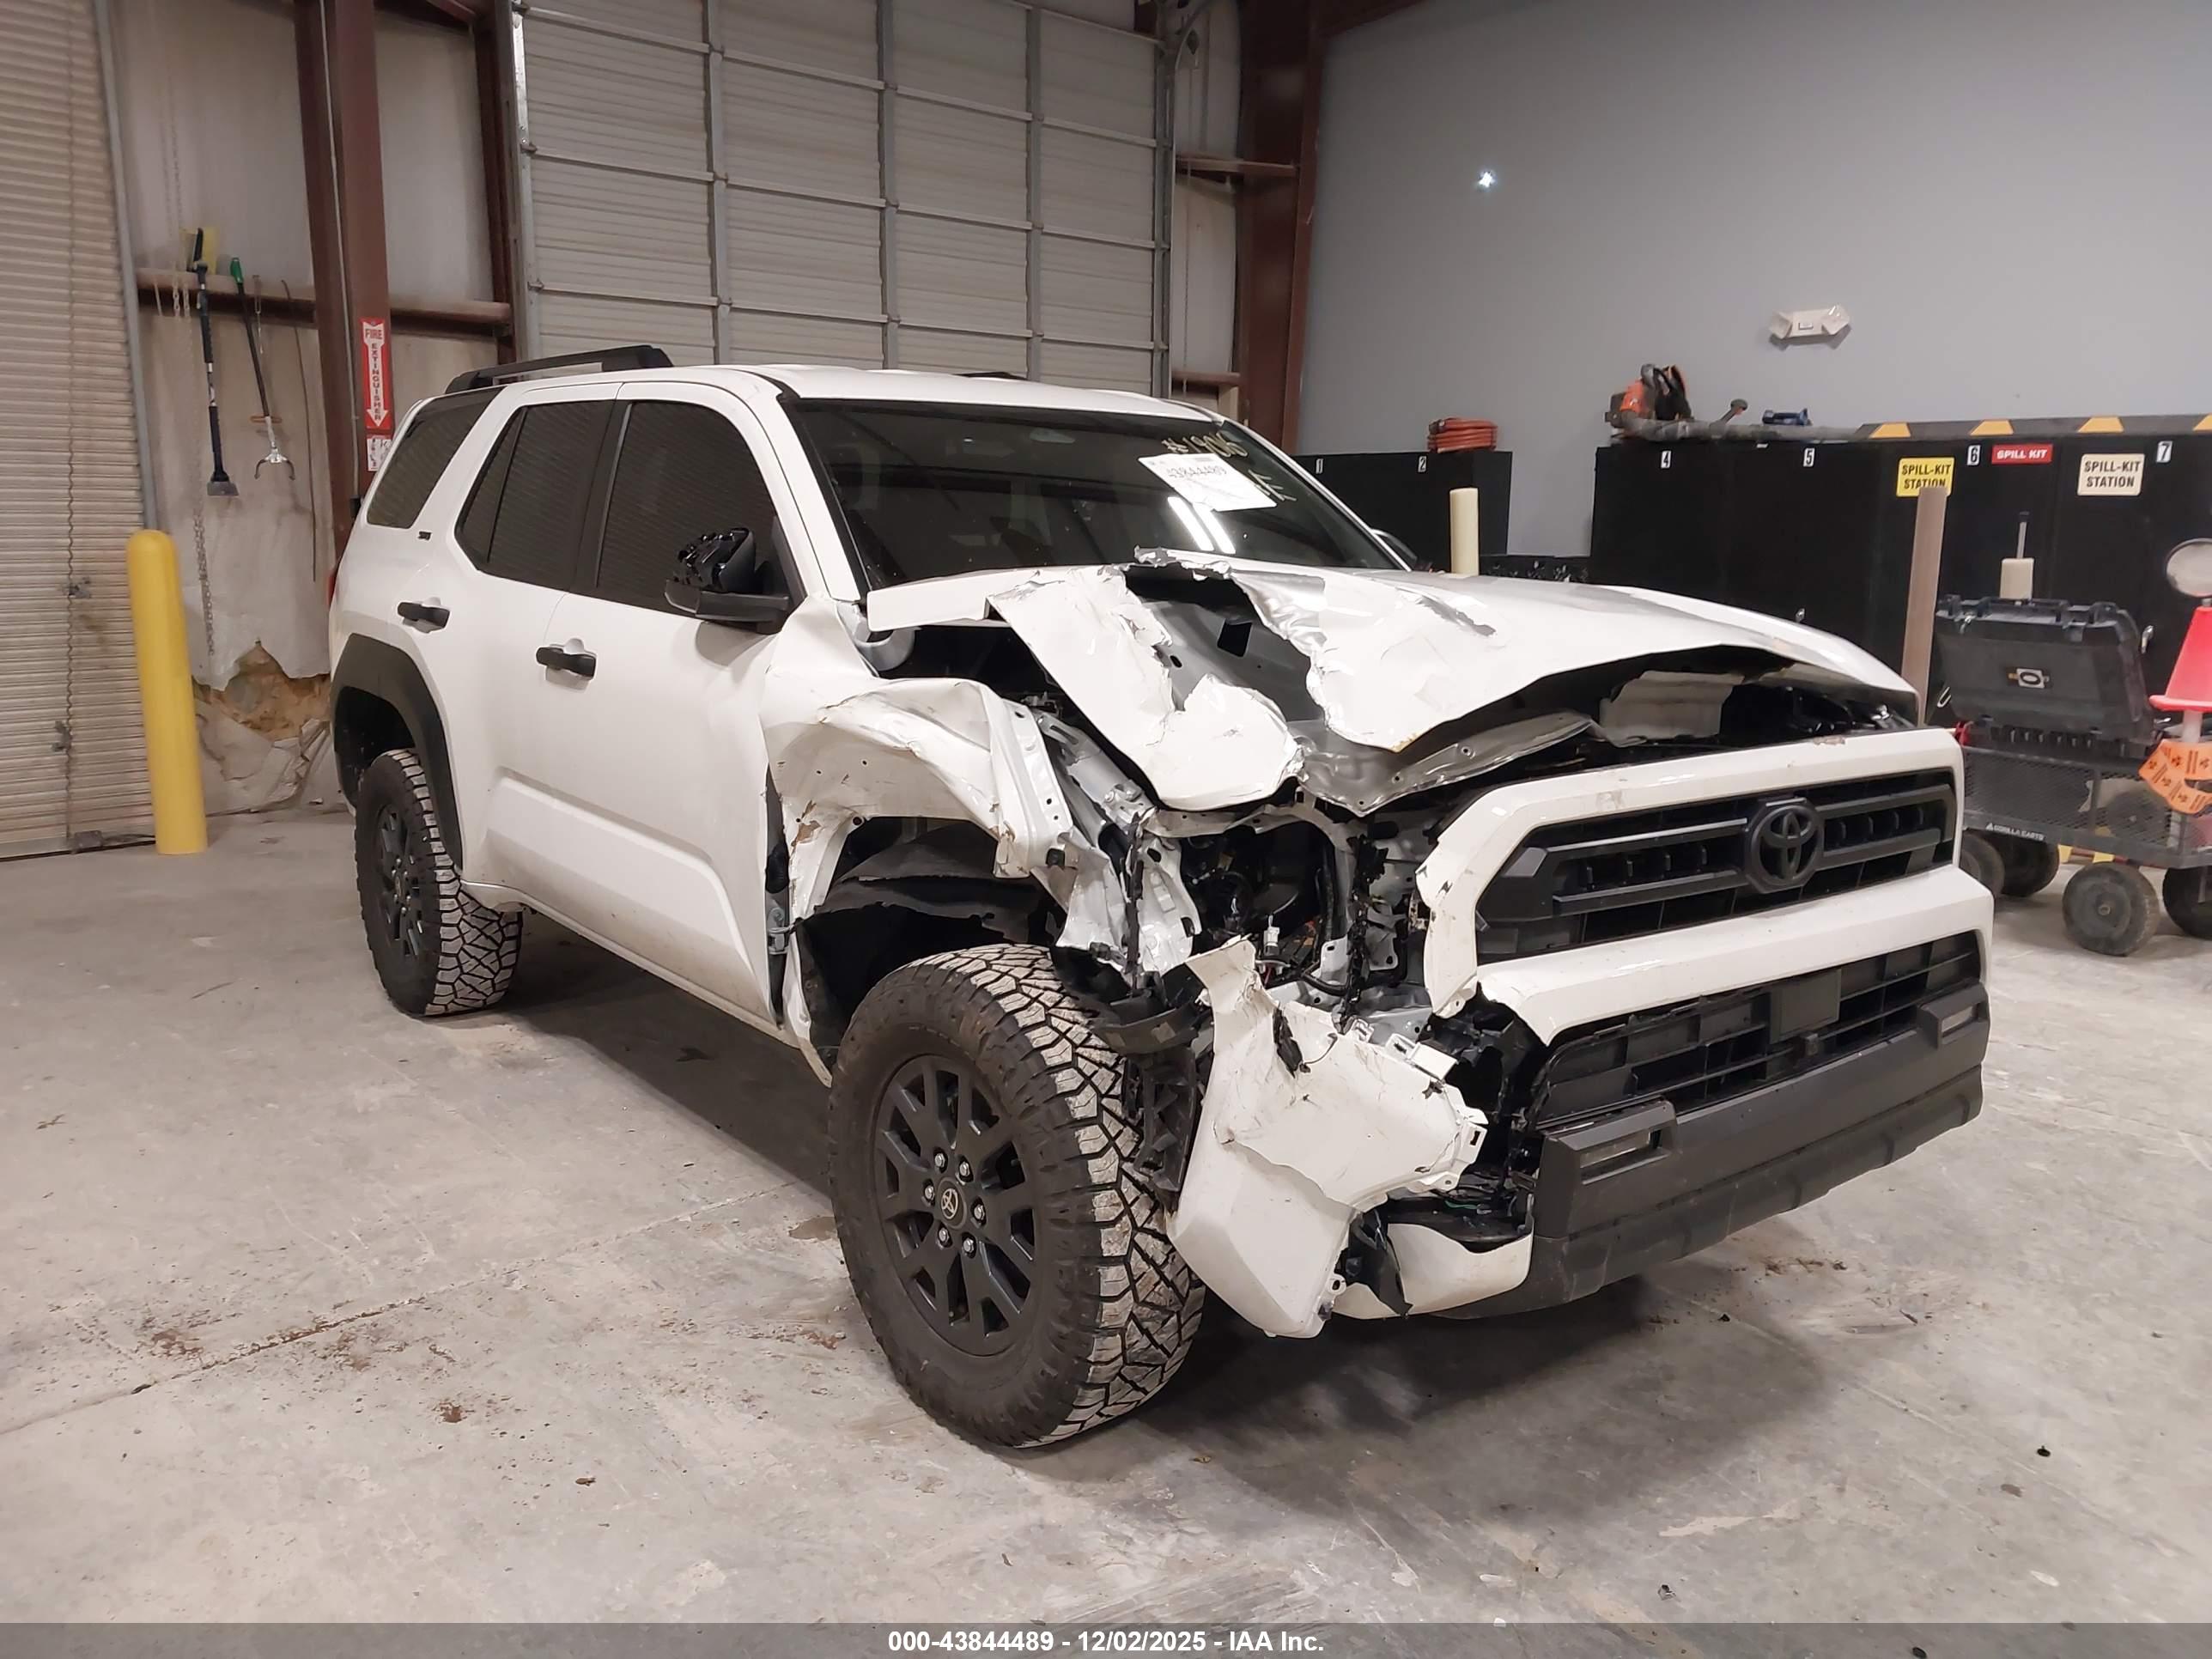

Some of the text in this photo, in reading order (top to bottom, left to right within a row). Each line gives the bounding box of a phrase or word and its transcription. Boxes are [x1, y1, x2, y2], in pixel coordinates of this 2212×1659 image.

[365, 329, 383, 340] FIRE
[371, 343, 381, 421] EXTINGUISHER
[1970, 446, 1978, 463] 6
[1996, 449, 2048, 459] SPILL KIT
[2160, 442, 2171, 461] 7
[1901, 464, 1952, 476] SPILL-KIT
[2084, 460, 2142, 472] SPILL-KIT
[1904, 477, 1947, 489] STATION
[2086, 476, 2136, 488] STATION
